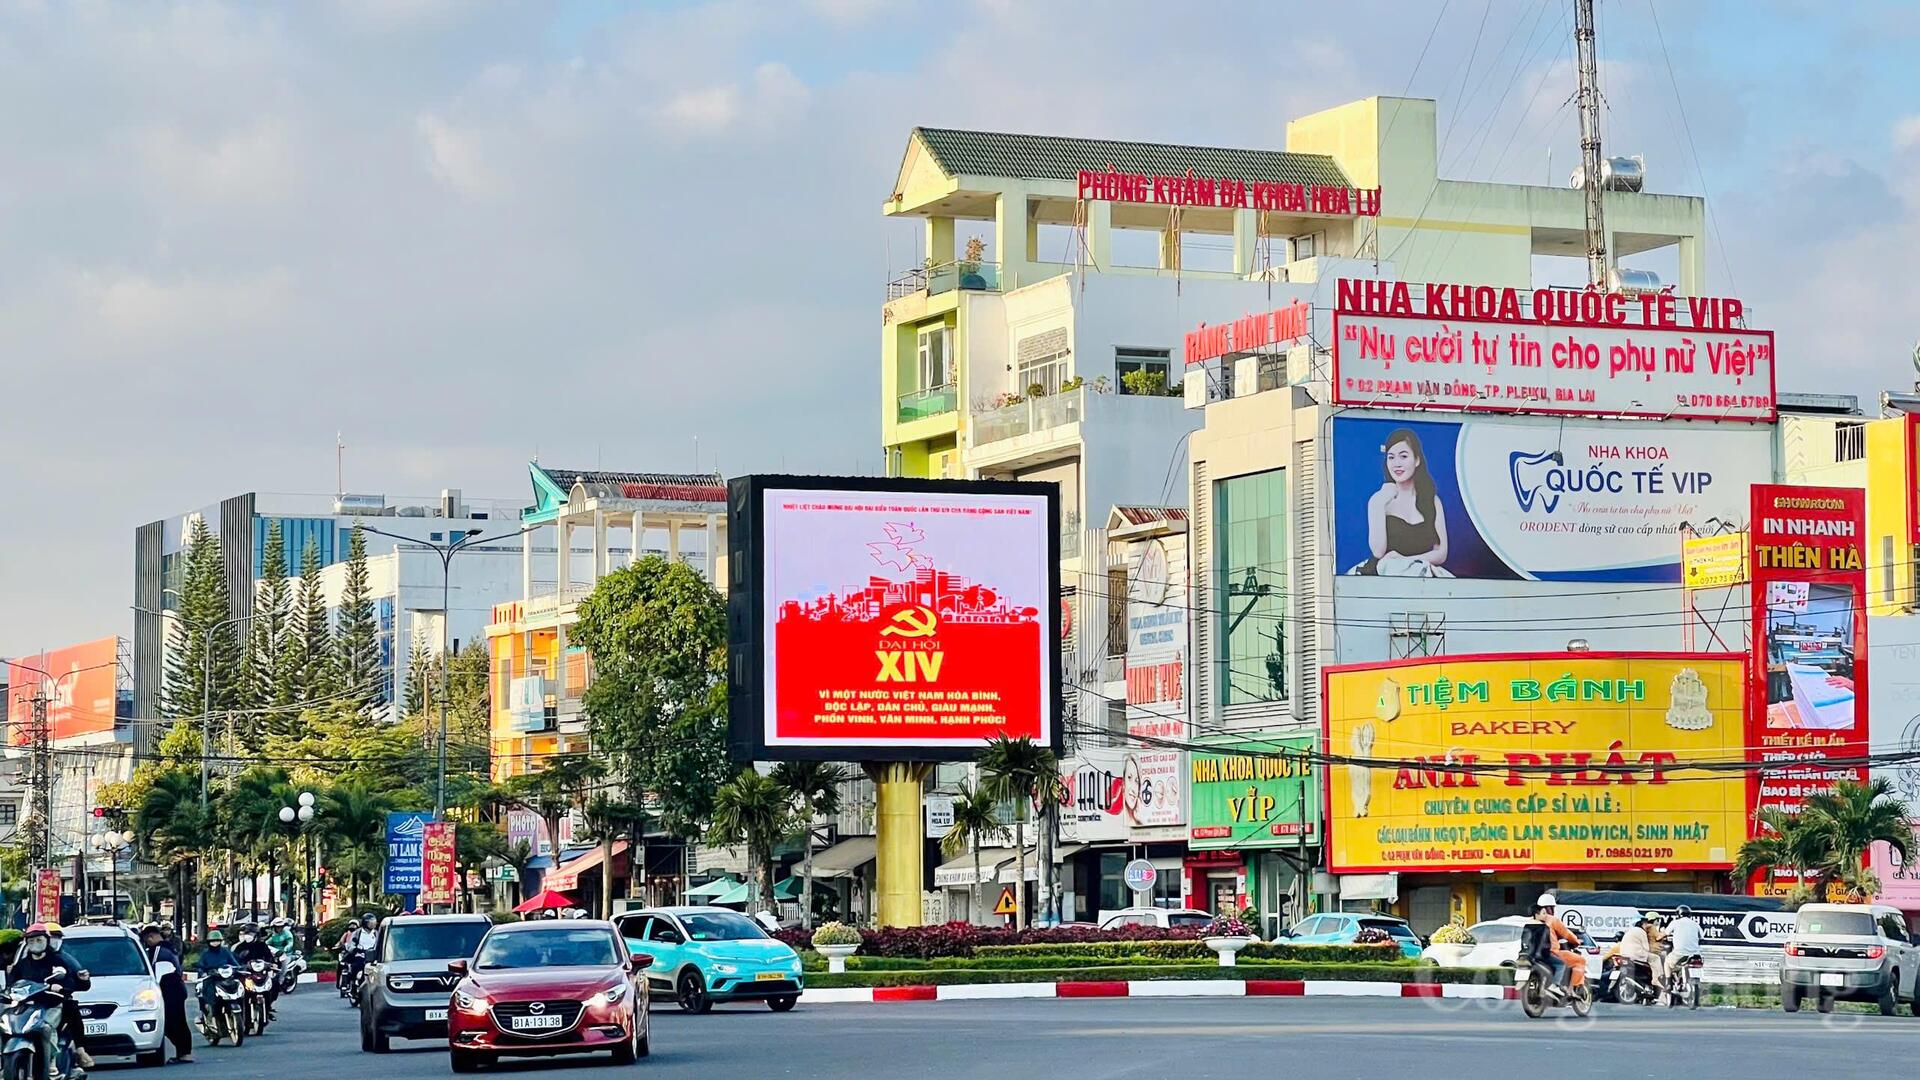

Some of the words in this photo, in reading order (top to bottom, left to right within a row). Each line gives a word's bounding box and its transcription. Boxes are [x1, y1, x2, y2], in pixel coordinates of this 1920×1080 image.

[1077, 163, 1147, 202] PHÒNG
[1219, 178, 1247, 208] ĐA
[1253, 180, 1307, 212] KHOA
[1311, 184, 1350, 214] HOA
[1335, 278, 1413, 314] NHA
[1423, 282, 1522, 320] KHOA
[1637, 285, 1677, 327] TẾ
[1687, 296, 1743, 330] VIP
[1405, 324, 1463, 364] cười
[1472, 330, 1499, 375] tự
[1509, 332, 1541, 367] tin
[1551, 336, 1600, 369] cho
[1609, 338, 1656, 382] phụ
[1665, 338, 1696, 374] nữ
[1555, 387, 1574, 401] GIA
[1691, 394, 1712, 407] 070
[1715, 395, 1737, 406] 664
[1741, 395, 1769, 407] 6789
[1588, 445, 1620, 459] NHA
[1625, 446, 1669, 460] KHOA
[1546, 461, 1623, 493] QUỐC
[1631, 463, 1664, 494] TẾ
[1672, 472, 1713, 494] VIP
[1774, 496, 1845, 510] SHOWROOM
[1519, 521, 1577, 533] ORODENT
[1578, 523, 1602, 536] dòng
[1617, 526, 1634, 534] cao
[1636, 523, 1653, 536] cấp
[1655, 523, 1677, 535] nhất
[1763, 518, 1783, 535] IN
[1787, 519, 1855, 536] NHANH
[1756, 541, 1821, 568] THIÊN
[1830, 543, 1863, 569] HÀ
[879, 640, 906, 650] ĐẠI
[913, 639, 940, 651] HỘI
[875, 651, 944, 682] XIV
[819, 689, 830, 699] VÌ
[832, 690, 856, 701] MỘT
[859, 689, 890, 699] NƯỚC
[892, 689, 915, 701] VIỆT
[918, 691, 944, 700] NAM
[1407, 676, 1489, 710] TIỆM
[1510, 672, 1645, 703] BÁNH
[824, 702, 847, 713] ĐỘC
[877, 702, 900, 712] DÂN
[879, 713, 902, 724] VĂN
[940, 715, 970, 726] HẠNH
[1450, 720, 1577, 736] BAKERY
[1762, 732, 1795, 746] THIẾT
[1796, 733, 1812, 746] KẾ
[1814, 737, 1826, 746] IN
[1828, 733, 1845, 746] ẤN
[1193, 759, 1220, 783] NHA
[1222, 756, 1256, 781] KHOA
[1503, 741, 1676, 786] PHÁT
[1823, 768, 1860, 781] DECAL
[1762, 786, 1788, 796] BAO
[1789, 784, 1801, 797] BÌ
[1227, 786, 1275, 822] VIP
[1424, 796, 1471, 815] CHUYÊN
[1474, 798, 1511, 814] CUNG
[1516, 792, 1547, 814] CẤP
[1572, 793, 1590, 813] VÀ
[510, 815, 536, 832] PHOTO
[1513, 825, 1543, 840] LAN
[1548, 824, 1633, 842] SANDWICH,
[1637, 824, 1668, 840] SINH
[1673, 821, 1709, 843] NHẬT
[389, 844, 398, 856] IN
[400, 843, 418, 857] LAM
[1492, 849, 1511, 859] GIA
[1513, 848, 1531, 859] LAI
[1606, 848, 1632, 858] 0985
[1634, 848, 1652, 858] 021
[1654, 848, 1673, 858] 970
[1702, 914, 1736, 926] NHÔM
